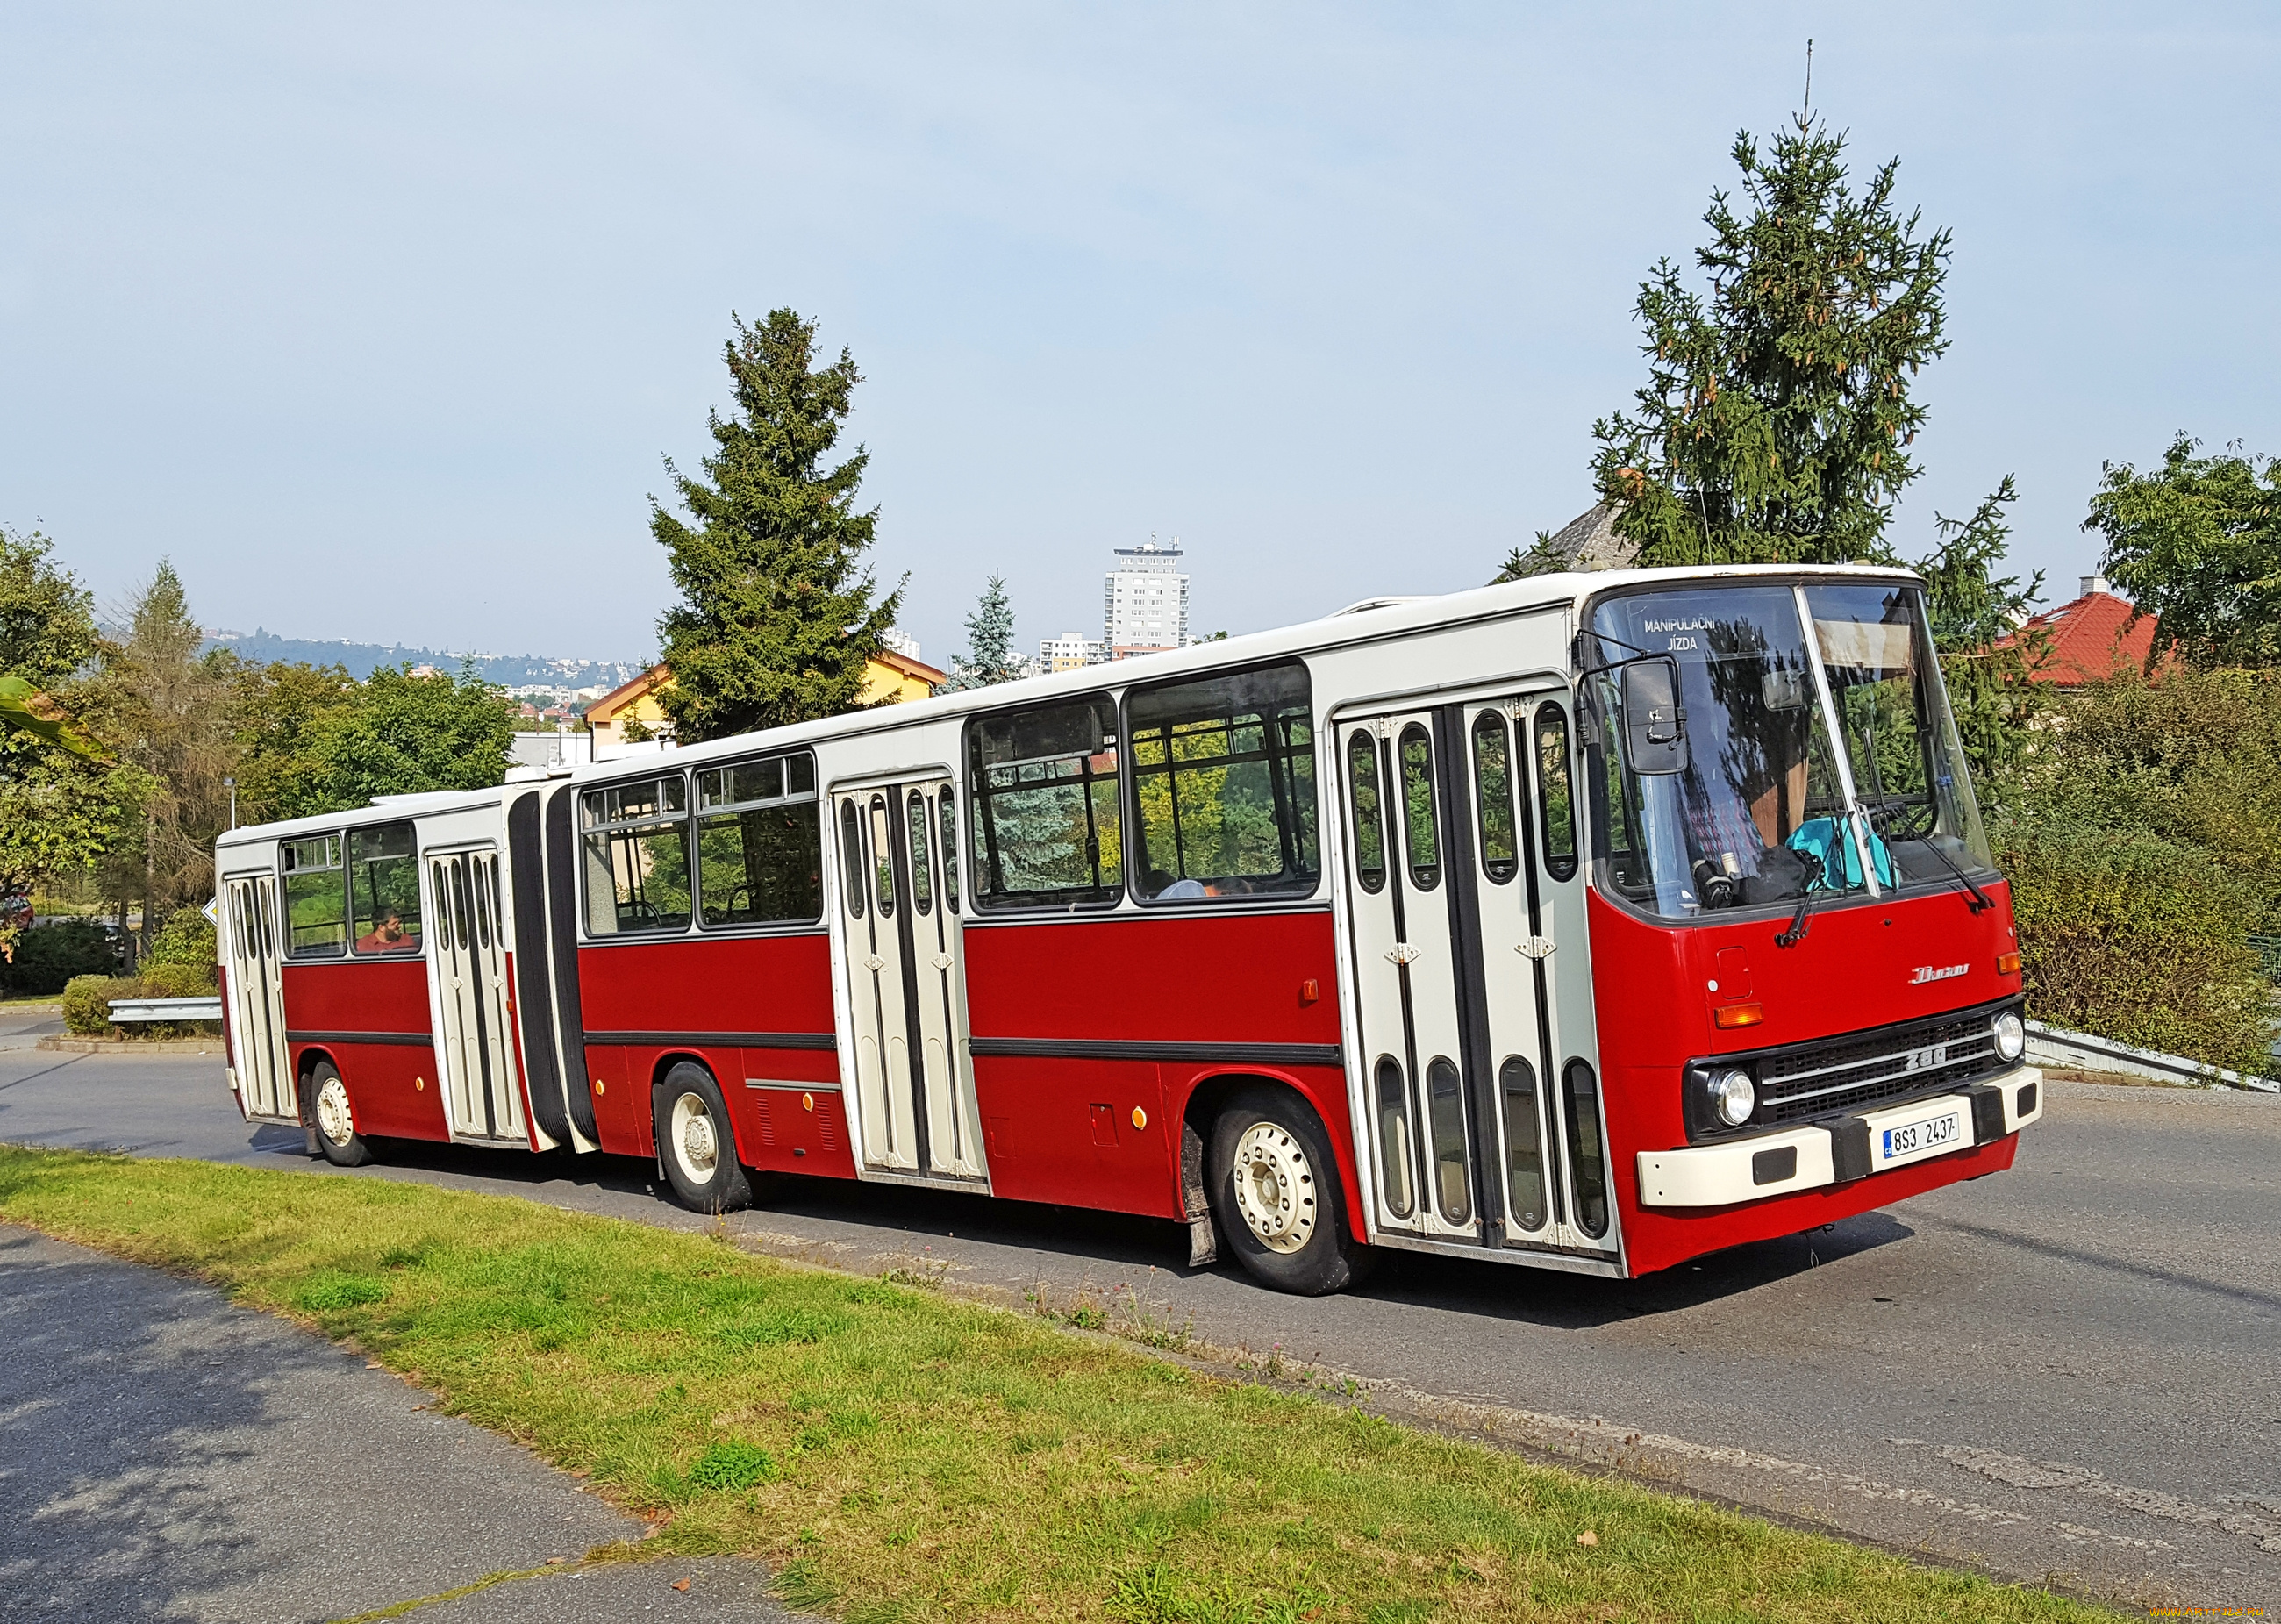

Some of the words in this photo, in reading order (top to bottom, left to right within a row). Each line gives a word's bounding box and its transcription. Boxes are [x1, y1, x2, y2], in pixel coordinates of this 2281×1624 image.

[1667, 634, 1698, 651] JÍZDA
[1906, 1047, 1947, 1071] 280
[1894, 1127, 1917, 1152] 8S3
[1926, 1117, 1953, 1144] 2437
